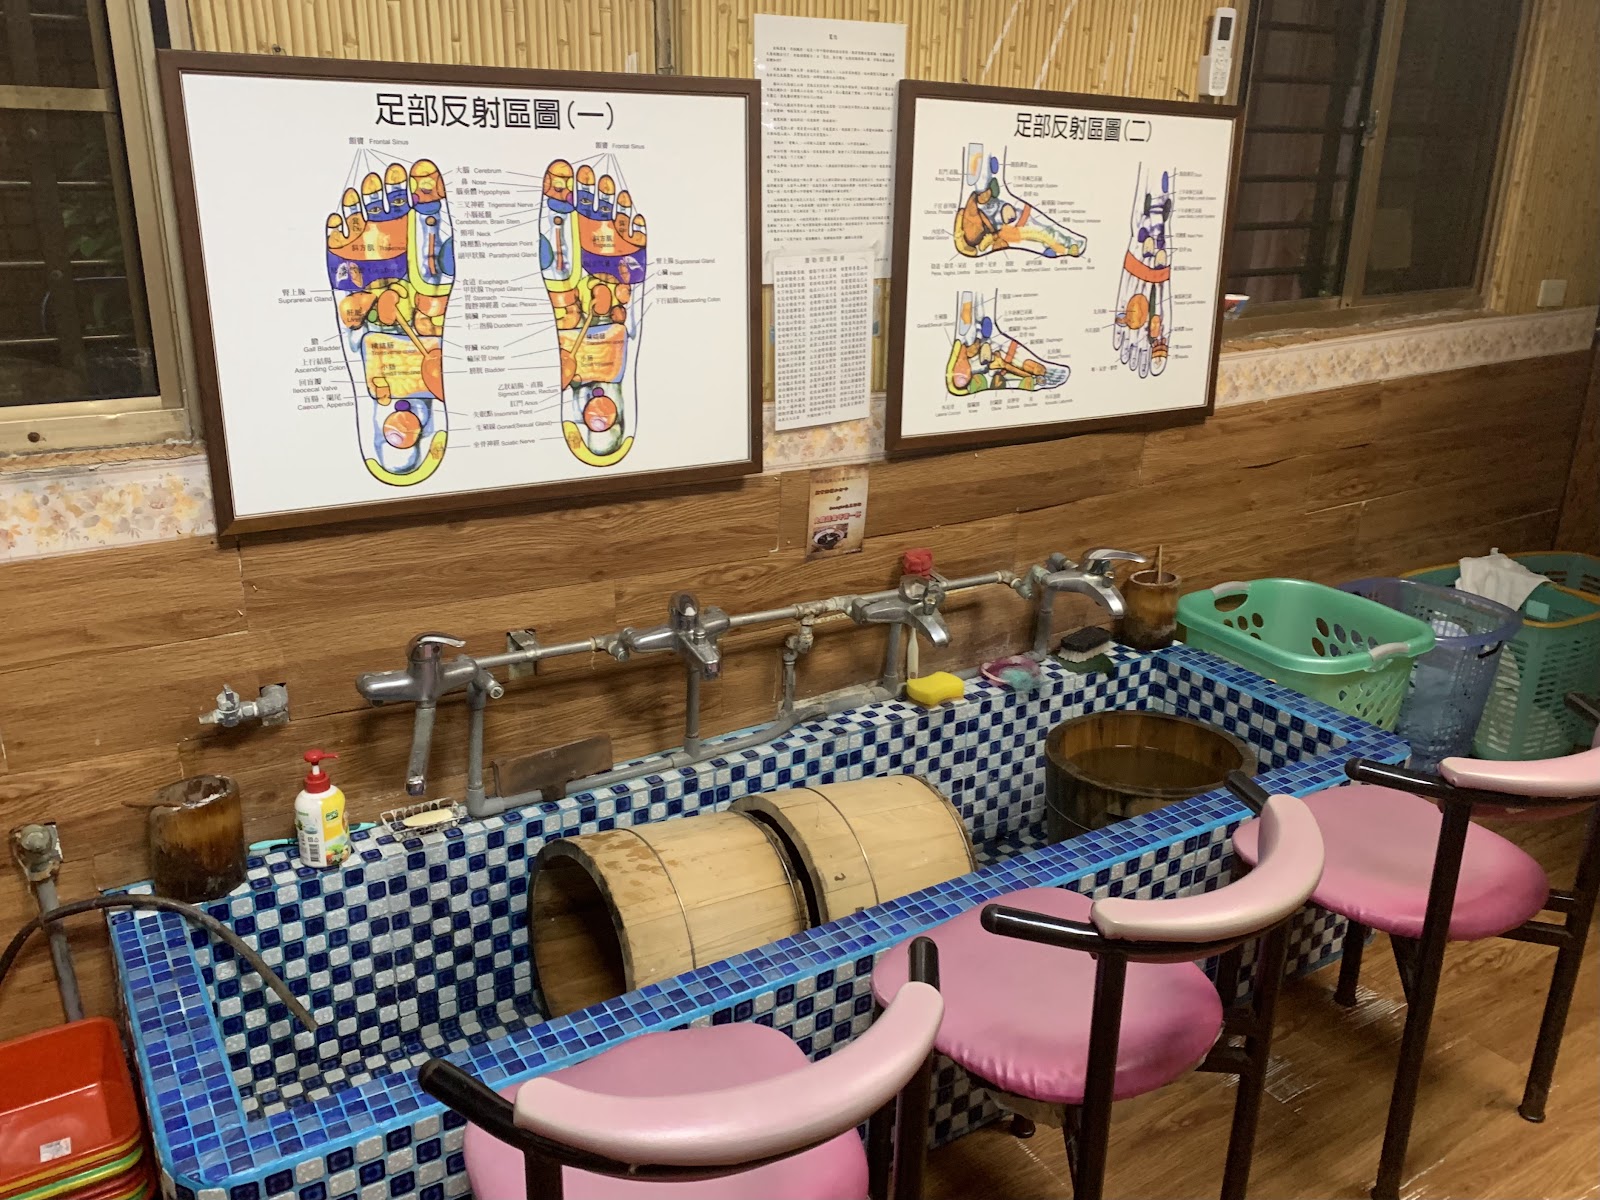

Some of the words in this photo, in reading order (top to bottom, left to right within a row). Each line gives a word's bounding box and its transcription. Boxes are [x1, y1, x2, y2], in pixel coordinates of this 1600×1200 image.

[375, 93, 614, 130] 足部反射區圖(一)
[369, 138, 390, 146] Frontal
[392, 138, 409, 146] Sinus
[294, 366, 327, 374] Ascending
[292, 385, 320, 394] Ileocecal
